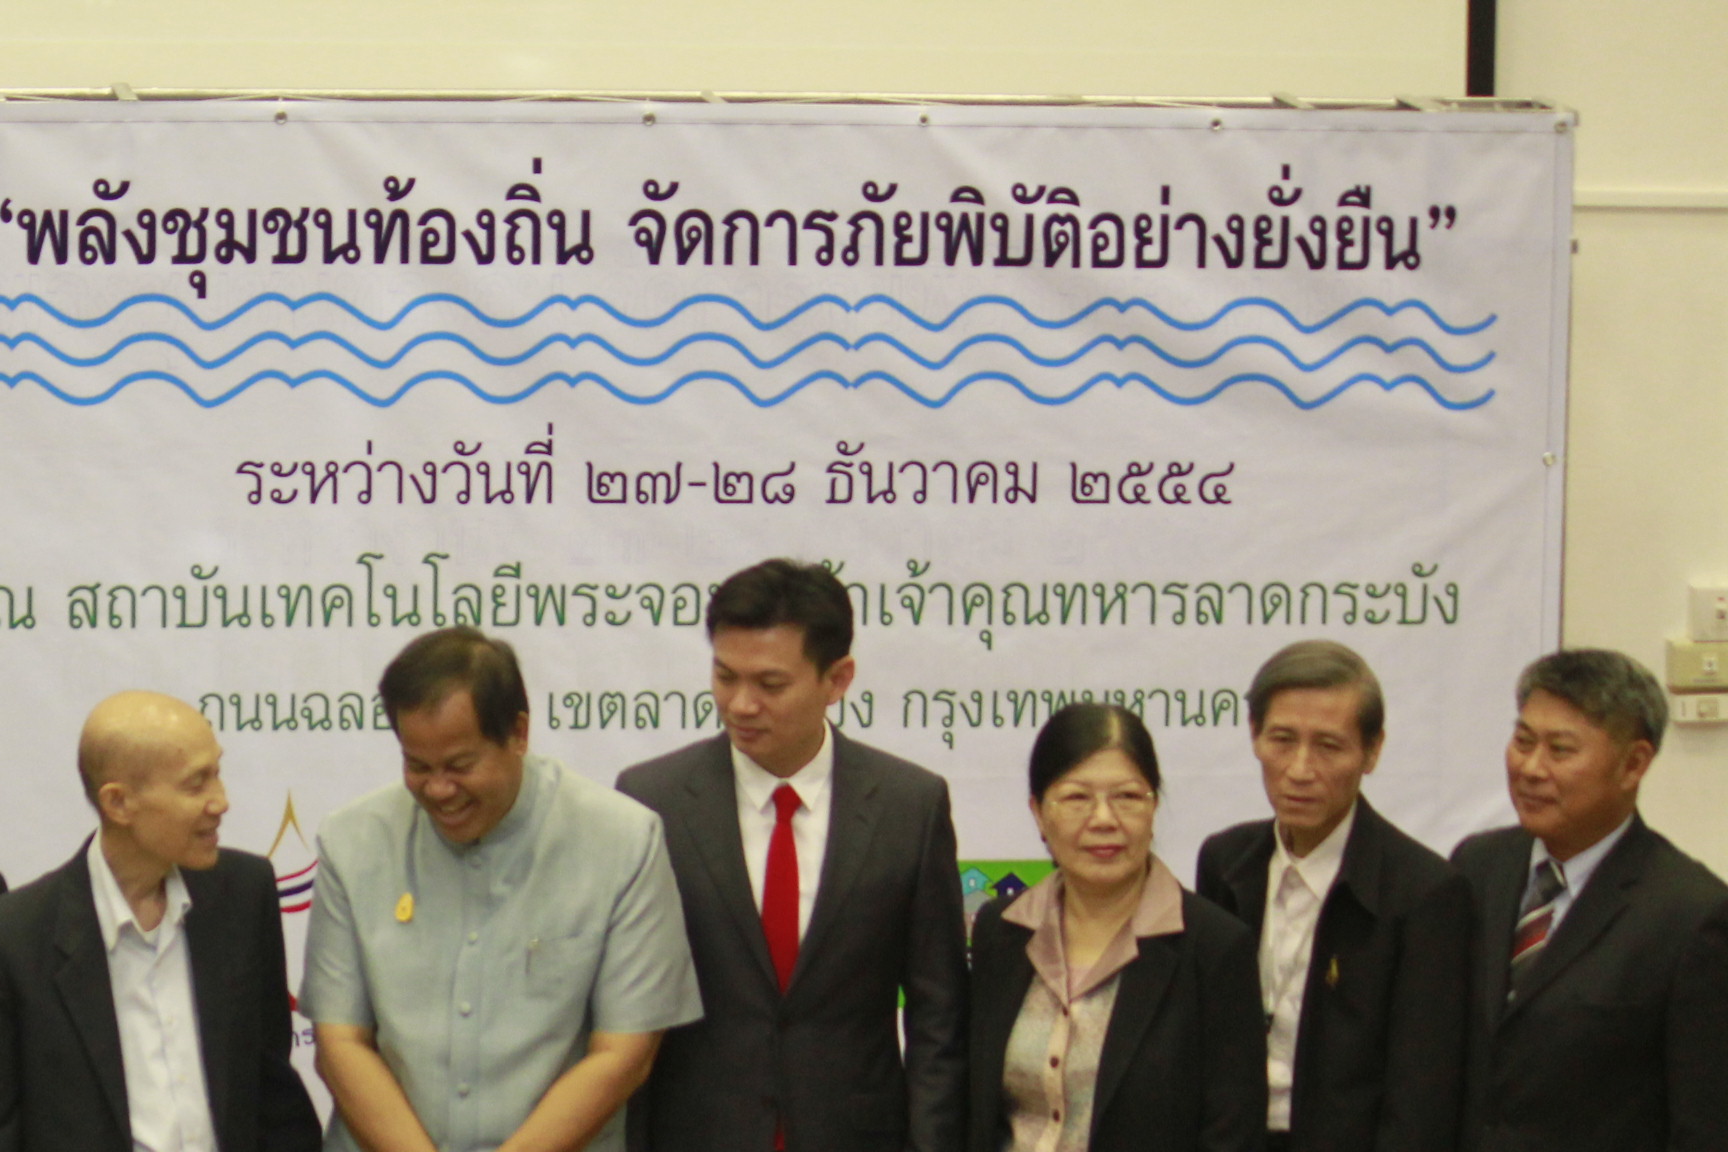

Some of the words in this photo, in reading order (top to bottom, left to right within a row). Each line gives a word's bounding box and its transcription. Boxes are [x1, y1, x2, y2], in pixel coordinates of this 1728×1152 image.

[235, 421, 554, 505] ระหว่างวันที่
[586, 461, 795, 504] ๒๗-๒๘
[825, 440, 1038, 506] ธันวาคม
[1069, 461, 1235, 505] ๒๕๕๔
